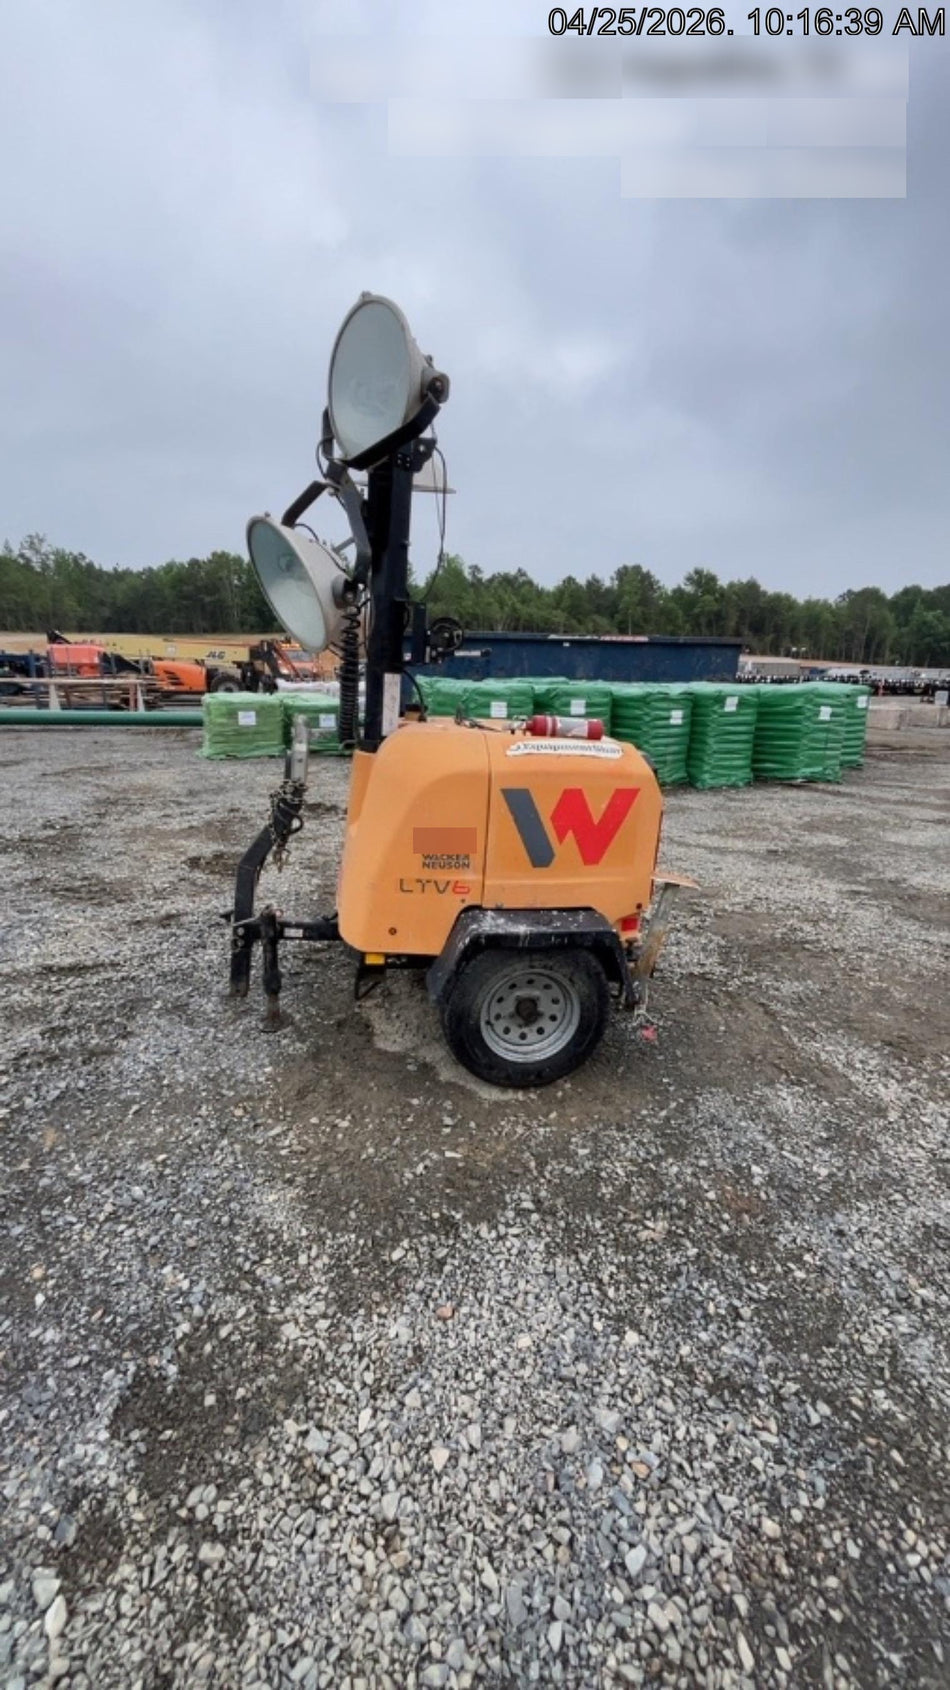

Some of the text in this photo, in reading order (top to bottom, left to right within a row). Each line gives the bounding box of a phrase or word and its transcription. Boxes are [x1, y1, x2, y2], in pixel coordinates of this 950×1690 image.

[422, 853, 470, 861] WACKER
[422, 861, 470, 870] NEUSON
[399, 878, 471, 895] LTV6
